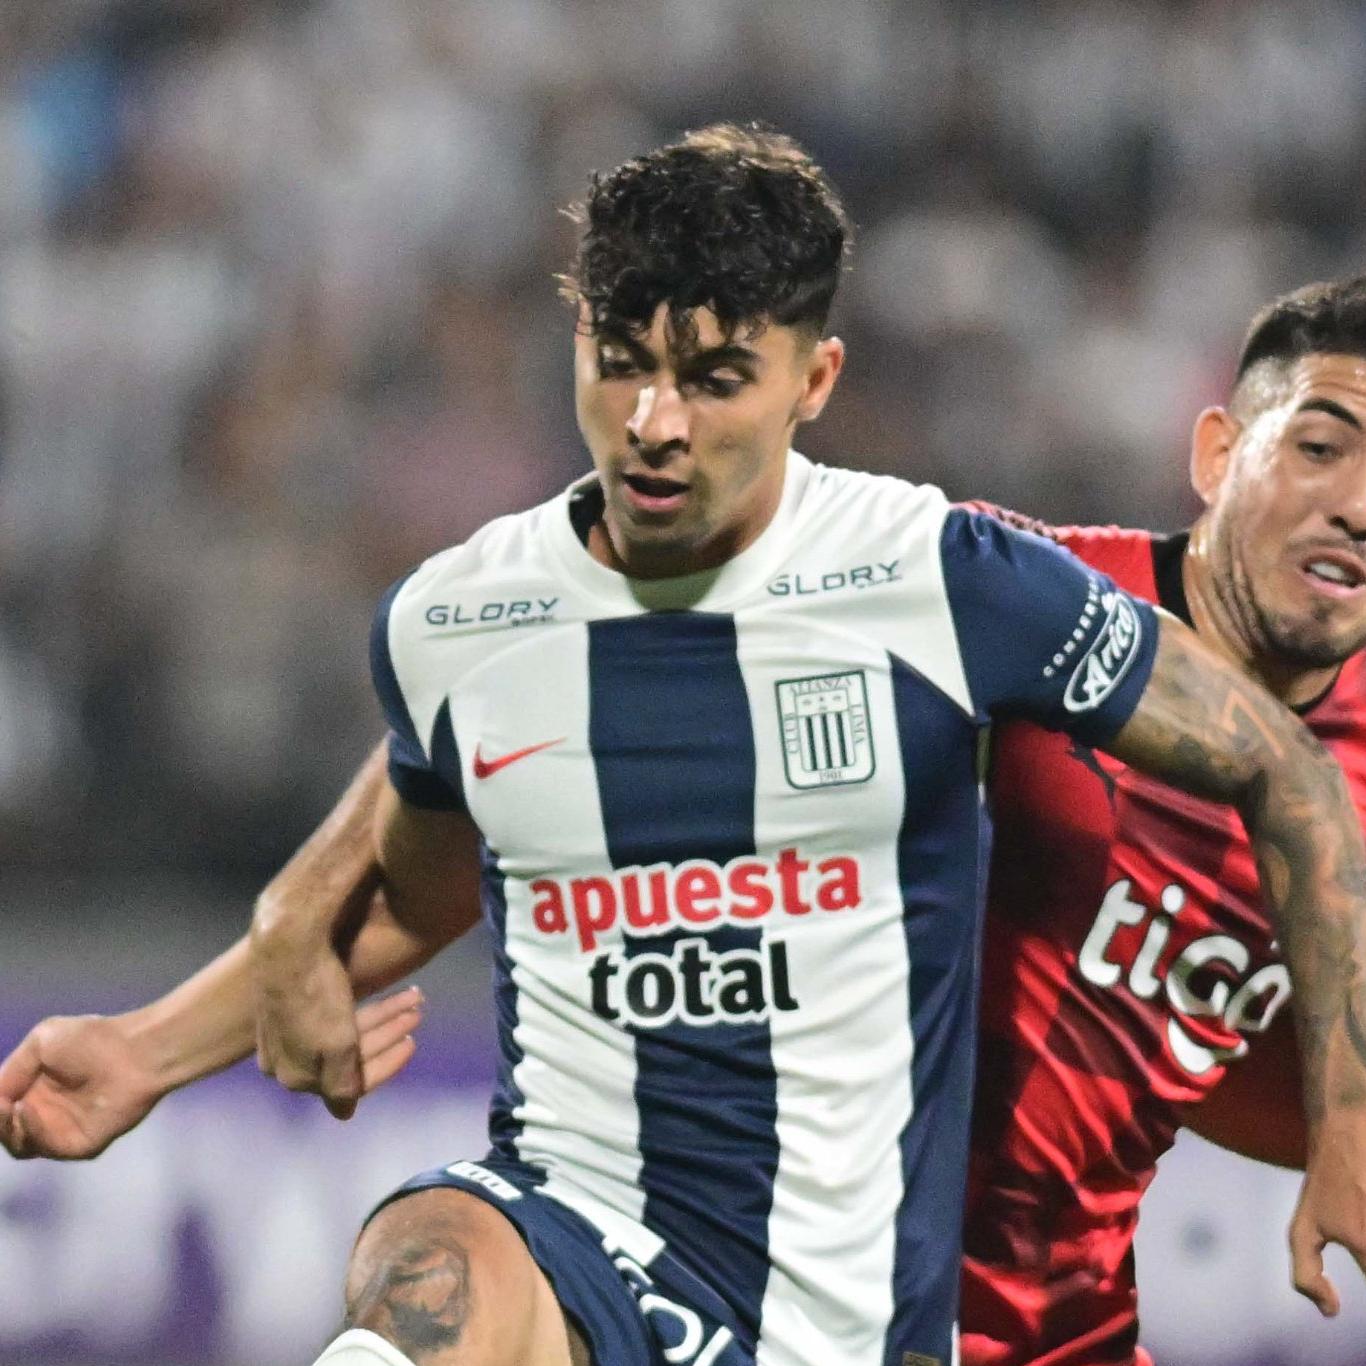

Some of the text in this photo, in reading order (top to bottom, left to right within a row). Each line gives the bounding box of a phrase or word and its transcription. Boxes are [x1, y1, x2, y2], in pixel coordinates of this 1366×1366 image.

[426, 597, 559, 625] GLORY
[766, 560, 899, 596] GLORY
[530, 848, 862, 953] apuesta
[588, 939, 799, 1020] total
[1079, 879, 1292, 1074] tigo
